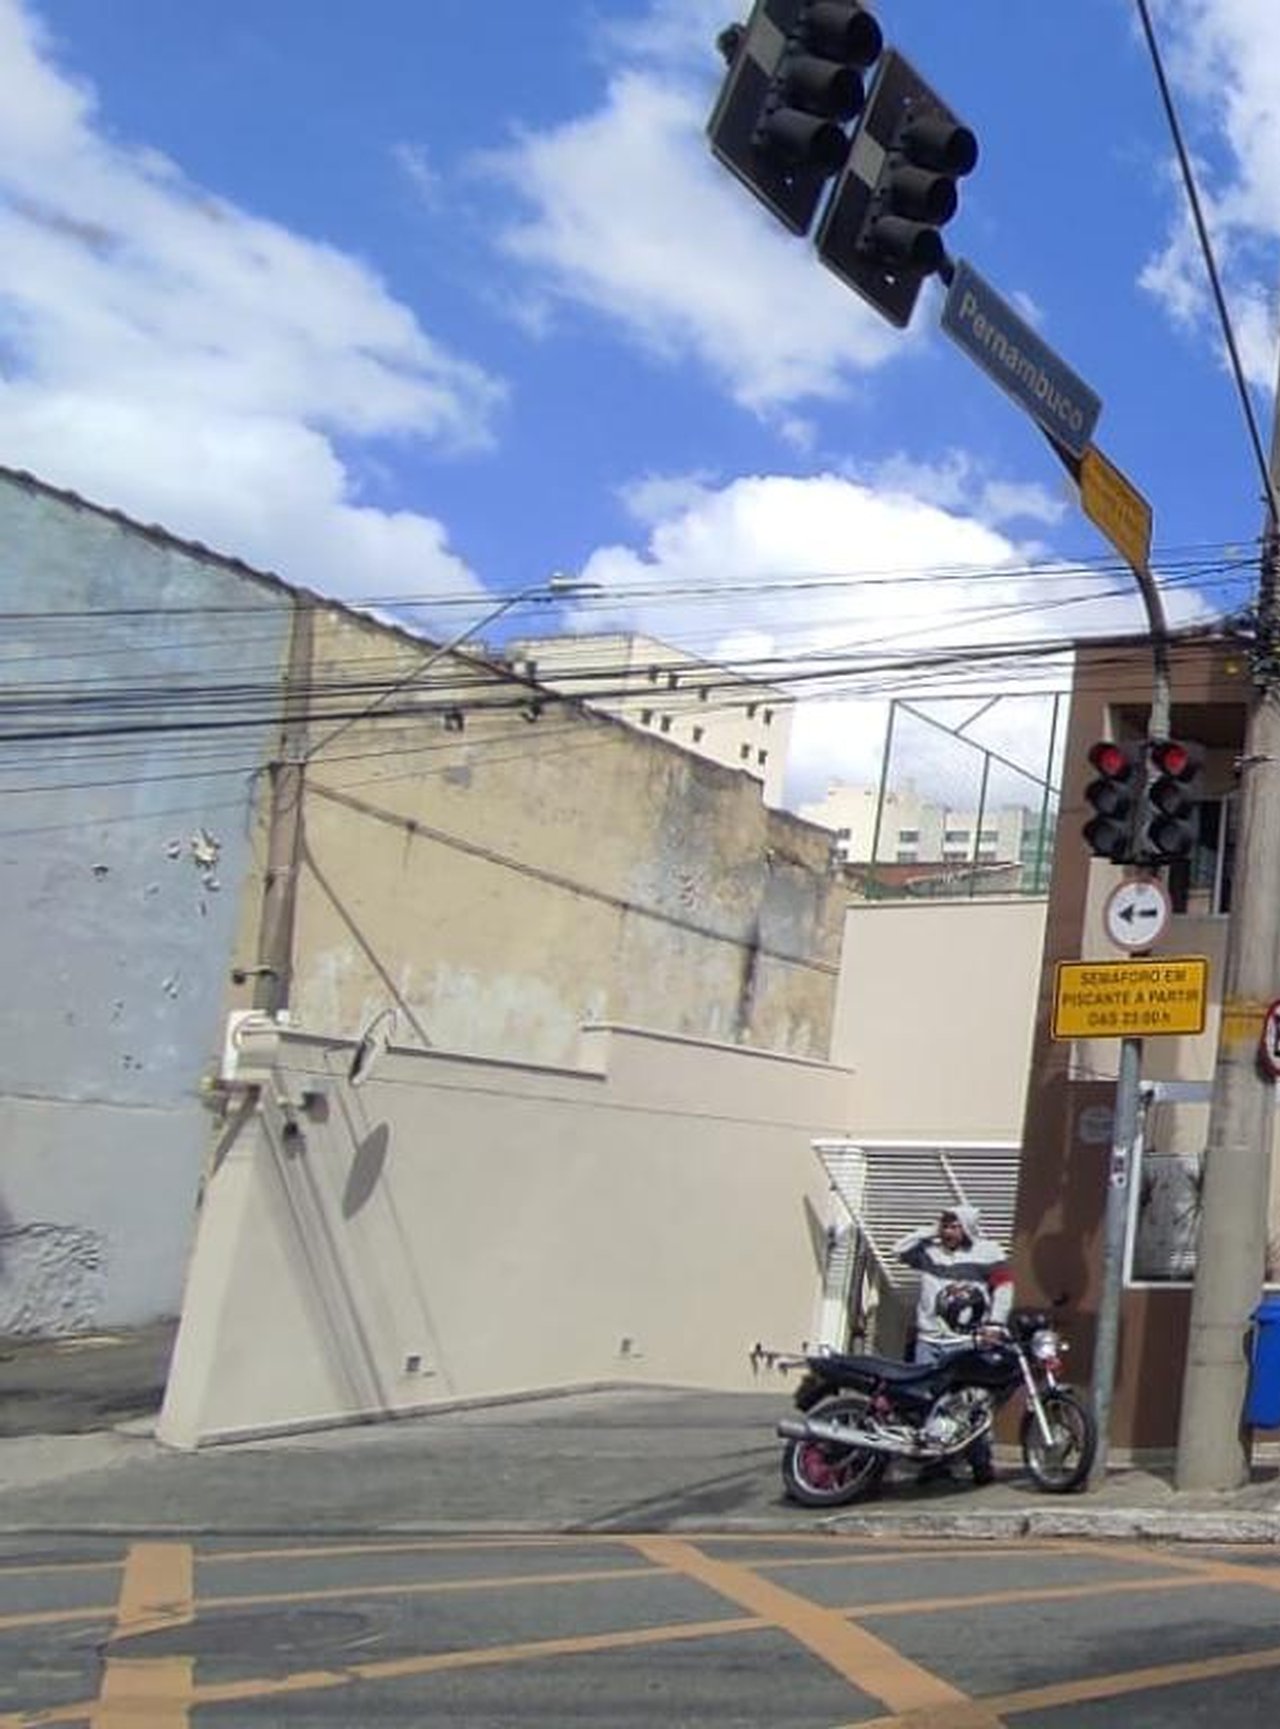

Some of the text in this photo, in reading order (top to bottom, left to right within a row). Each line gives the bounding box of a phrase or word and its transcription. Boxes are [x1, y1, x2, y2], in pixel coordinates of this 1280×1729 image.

[959, 290, 1083, 431] Pernambuco
[1061, 991, 1129, 1008] PISCANTE
[1134, 991, 1146, 1005] A
